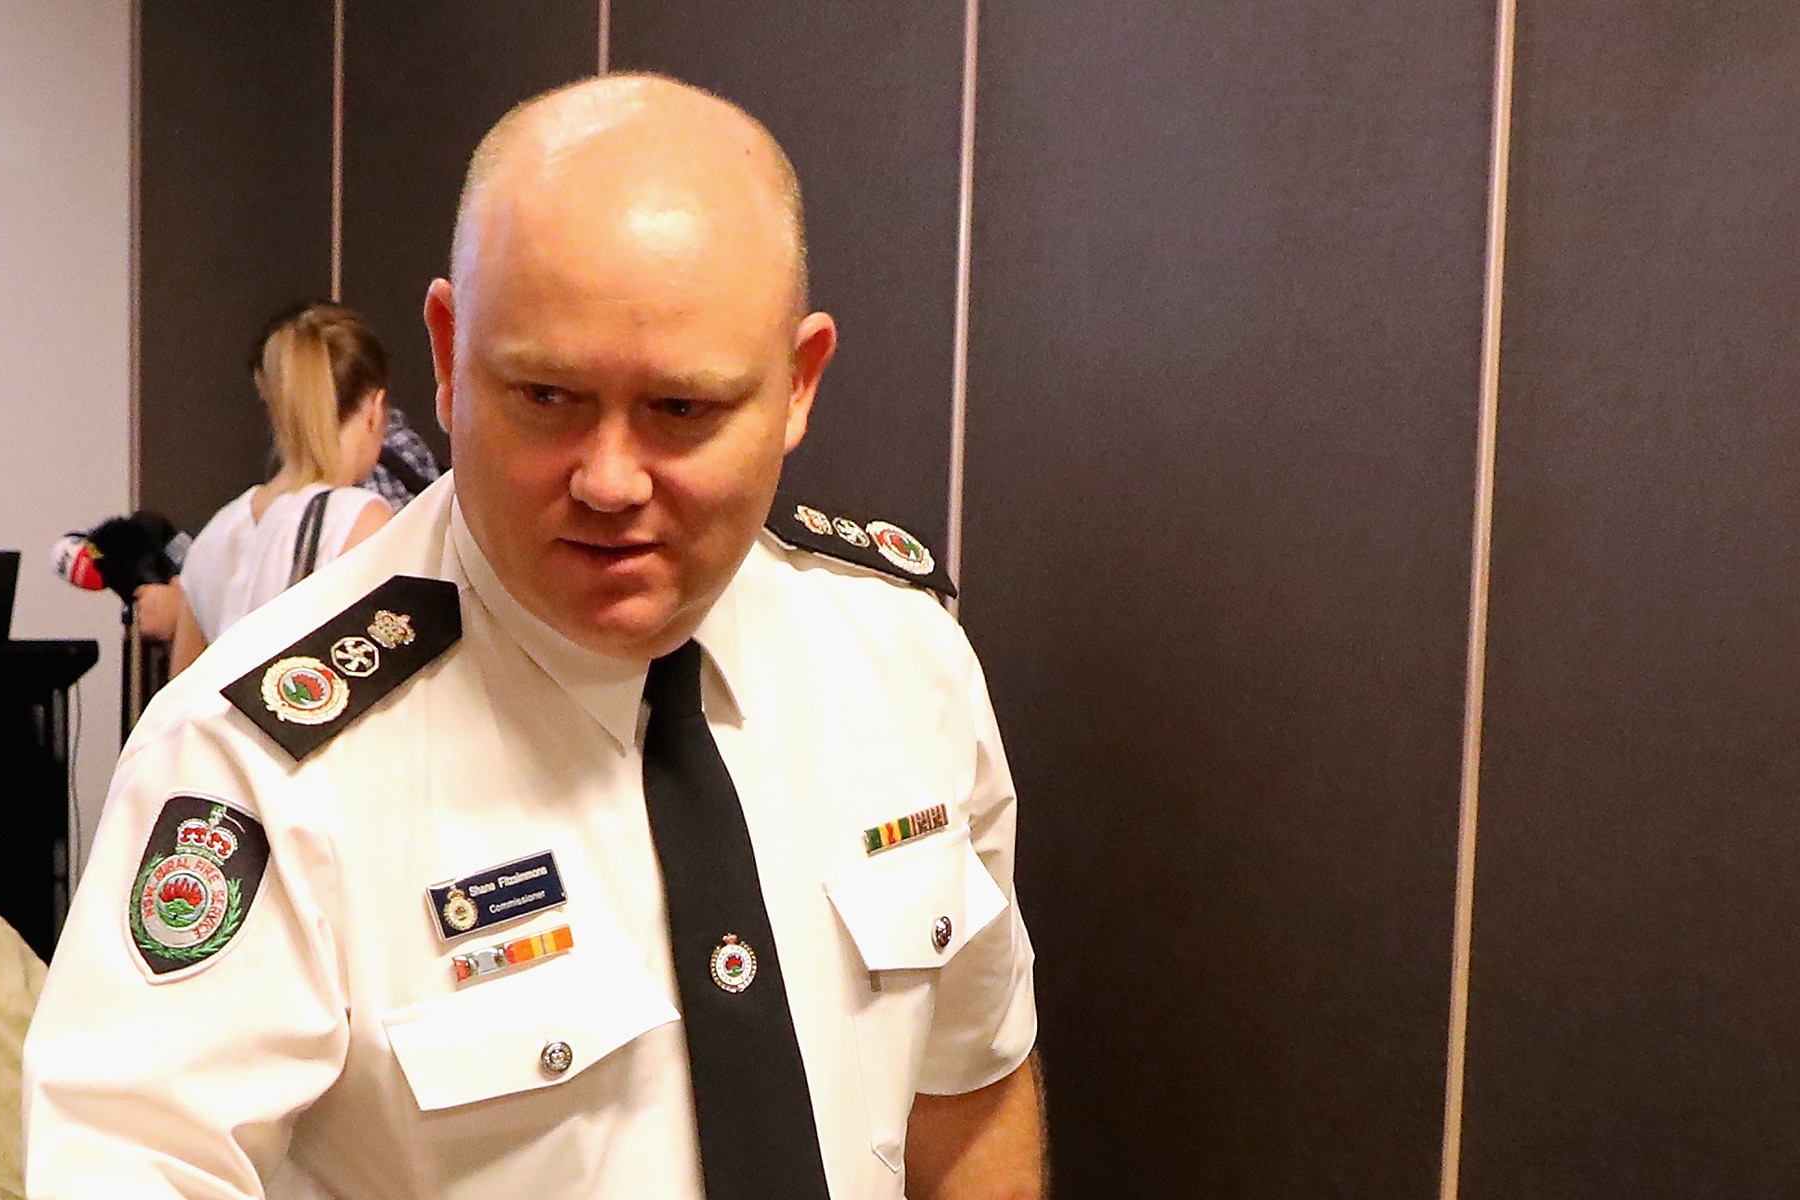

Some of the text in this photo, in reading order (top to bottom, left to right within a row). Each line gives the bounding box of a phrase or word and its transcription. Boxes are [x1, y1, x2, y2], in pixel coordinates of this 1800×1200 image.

[155, 858, 190, 881] RURAL
[194, 860, 220, 883] FIRE
[468, 882, 496, 897] Shane
[489, 890, 546, 914] Commissioner
[191, 889, 225, 939] SERVICE
